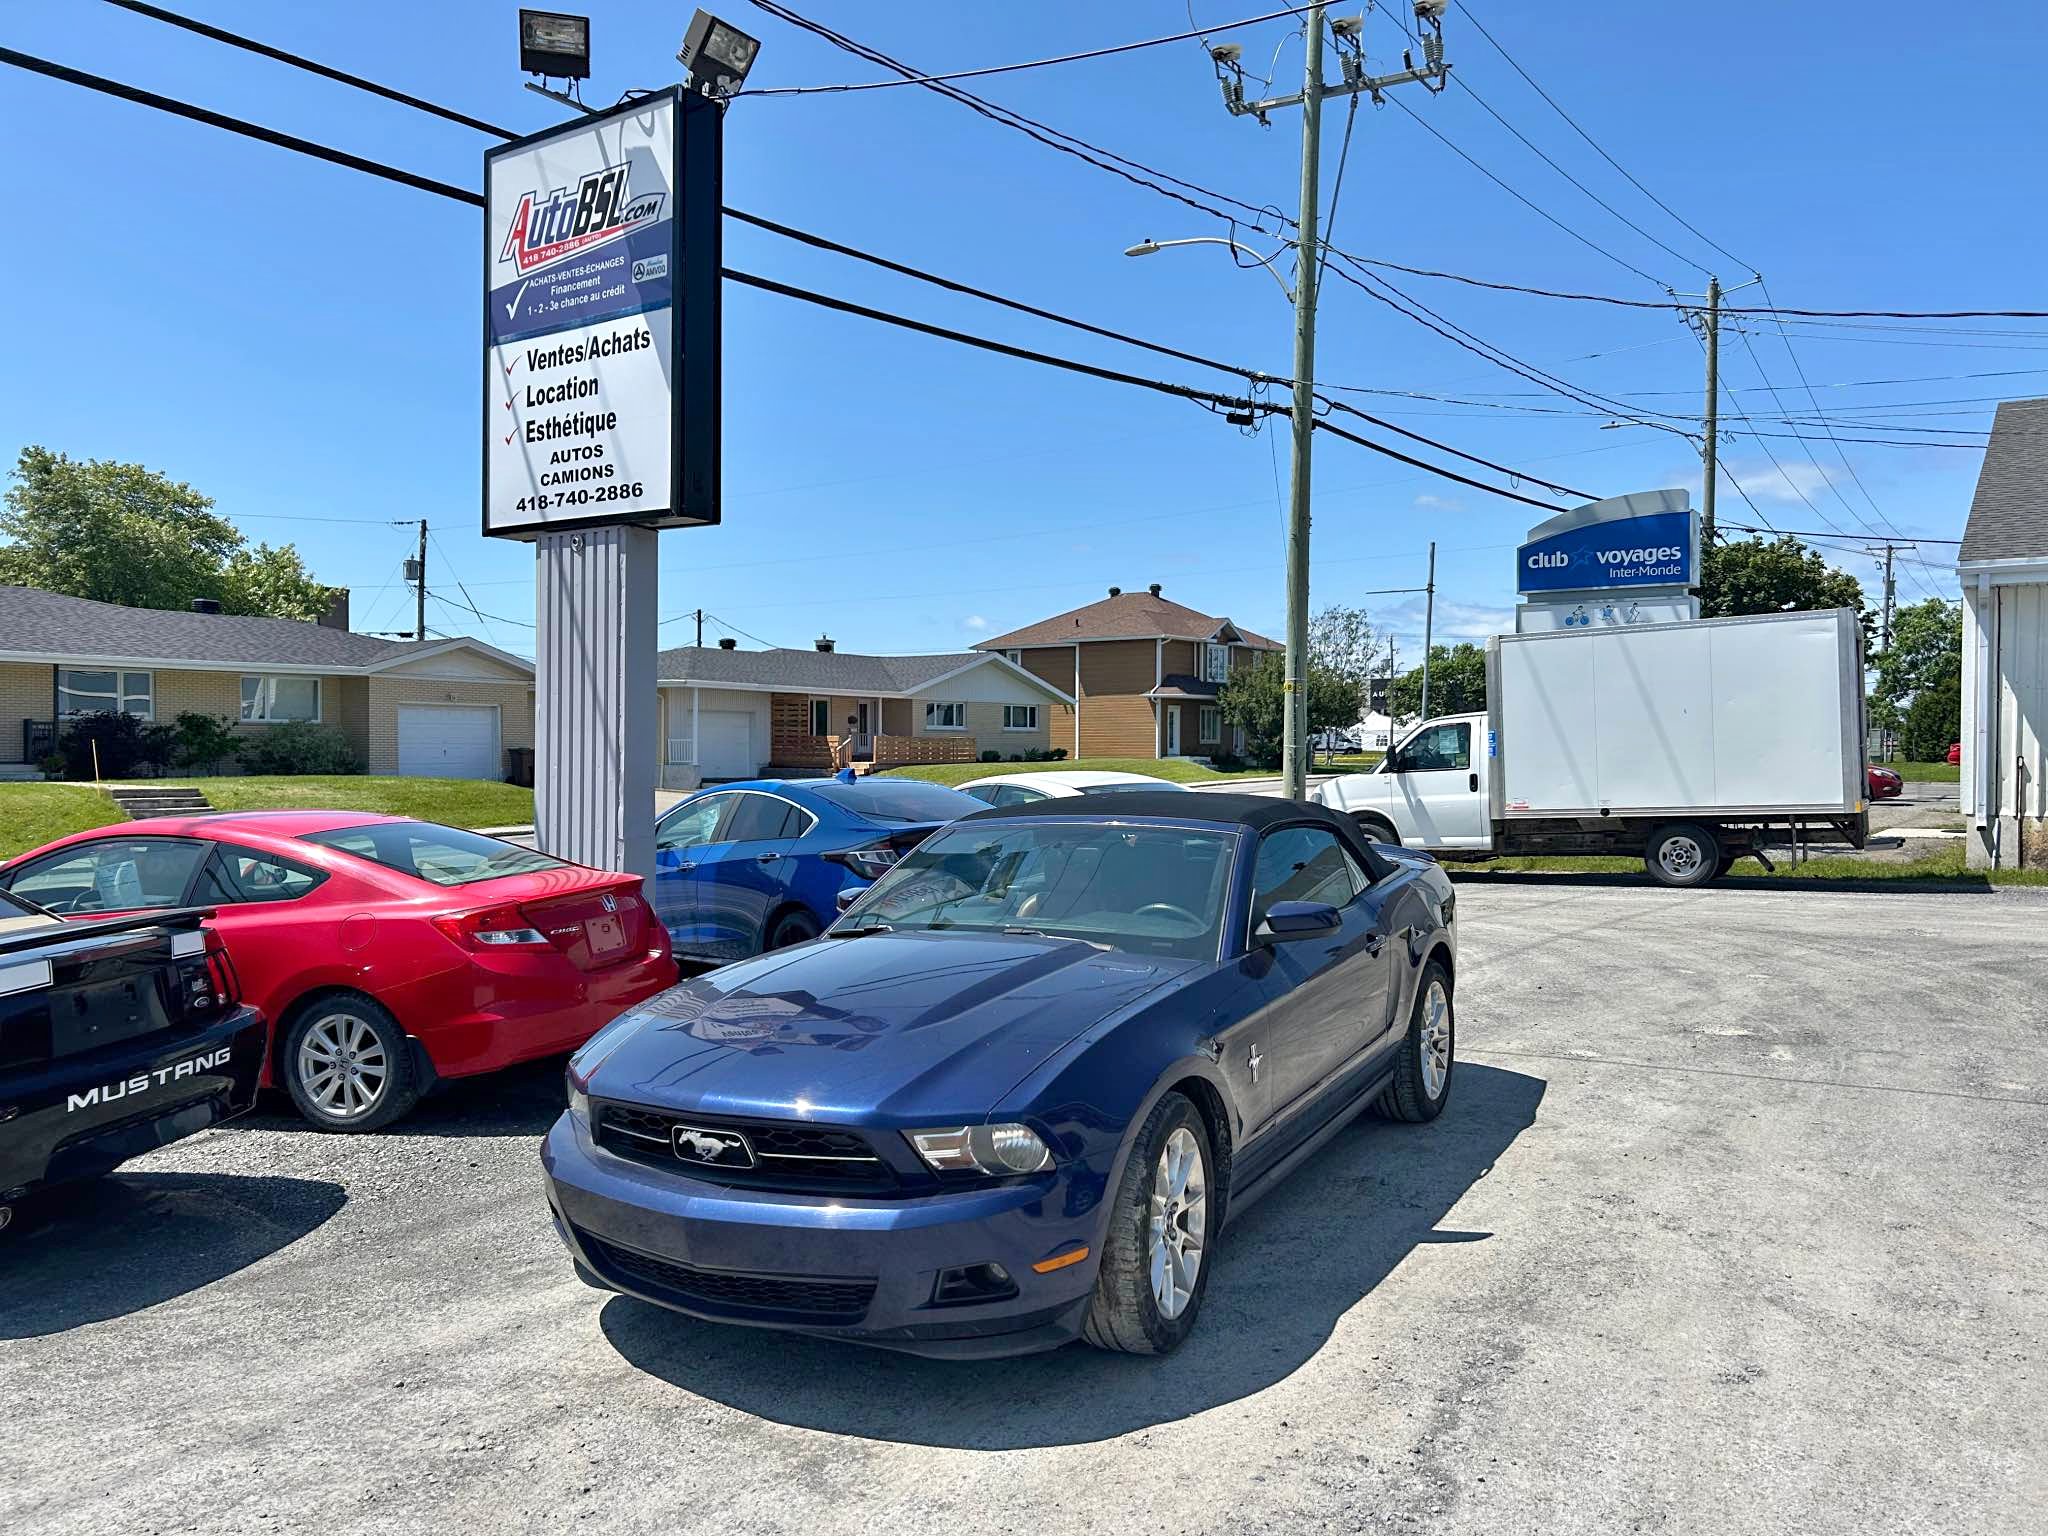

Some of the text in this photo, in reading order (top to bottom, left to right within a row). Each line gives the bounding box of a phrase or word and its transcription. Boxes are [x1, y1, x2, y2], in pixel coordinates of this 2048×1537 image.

[523, 253, 539, 264] 418
[551, 275, 601, 296] Financement
[560, 293, 589, 309] chance
[590, 291, 601, 302] au
[602, 284, 625, 299] crédit
[527, 327, 651, 372] Ventes/Achats
[526, 376, 599, 408] Location
[526, 411, 617, 444] Esthétique
[550, 444, 604, 465] AUTOS
[540, 464, 615, 487] CAMIONS
[516, 482, 644, 512] 418-740-2886
[1528, 546, 1682, 569] club voyages
[1609, 564, 1681, 578] Inter-Monde
[67, 1047, 231, 1112] MUSTANG
